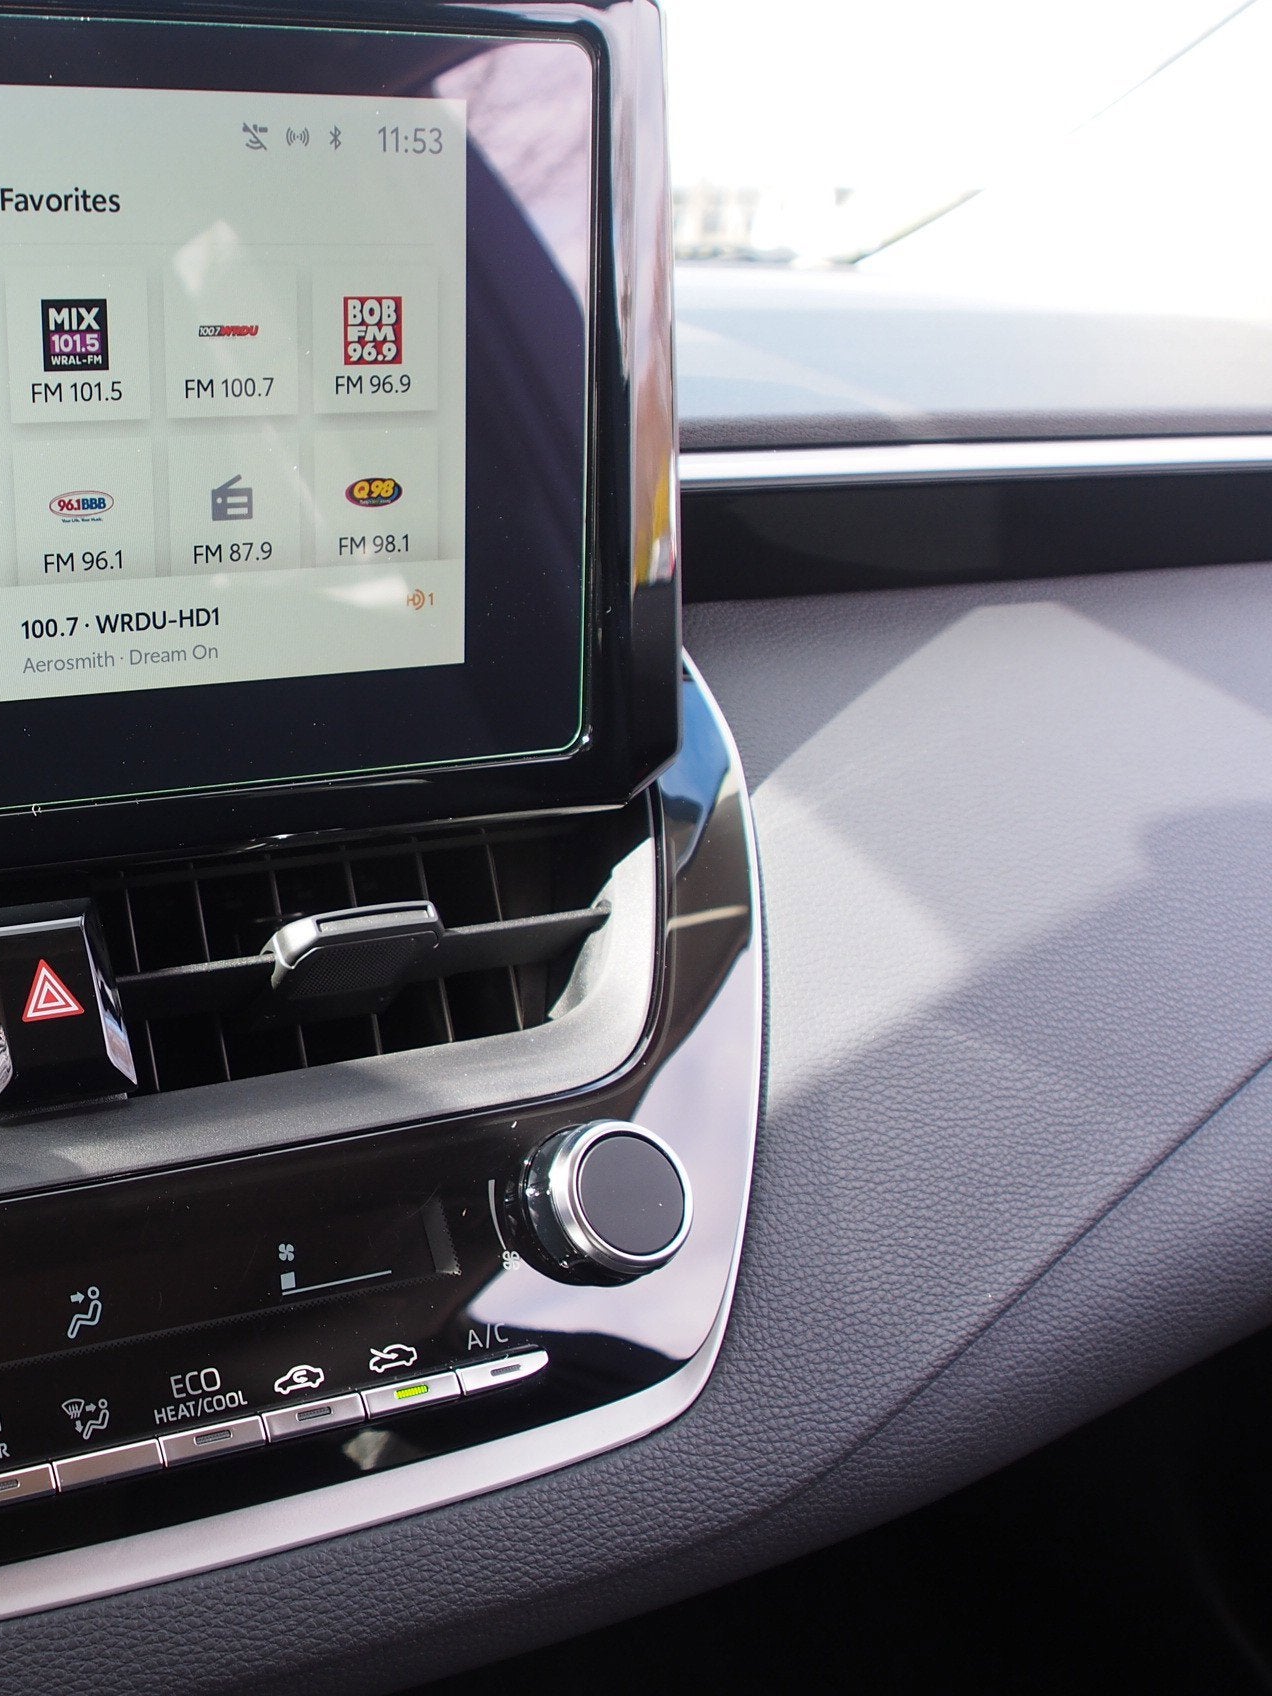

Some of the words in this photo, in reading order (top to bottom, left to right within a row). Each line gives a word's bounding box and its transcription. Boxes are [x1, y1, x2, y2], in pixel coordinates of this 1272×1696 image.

[377, 126, 444, 155] 11:53
[0, 187, 121, 213] Favorites
[48, 307, 101, 331] MIX
[347, 298, 397, 325] BOB
[51, 333, 100, 353] 101.5
[347, 325, 396, 342] FM
[51, 354, 103, 366] WRAL-FM
[347, 341, 397, 362] 96.9
[31, 382, 63, 403] FM
[70, 380, 123, 402] 101.5
[184, 379, 216, 399] FM
[221, 377, 274, 398] 100.7
[335, 374, 363, 395] FM
[369, 374, 411, 394] 96.9
[193, 544, 223, 564] FM
[229, 541, 273, 562] 87.9
[338, 536, 367, 556] FM
[372, 533, 410, 553] 98.1
[43, 553, 75, 573] FM
[81, 550, 124, 571] 96.1
[20, 616, 79, 639] 100.7
[95, 607, 221, 633] WRDU-HD1
[22, 651, 115, 674] Aerosmith
[130, 647, 187, 666] Dream
[193, 643, 219, 661] On
[466, 1322, 510, 1351] A/C
[169, 1367, 222, 1399] ECO
[153, 1390, 249, 1424] HEAT/COOL
